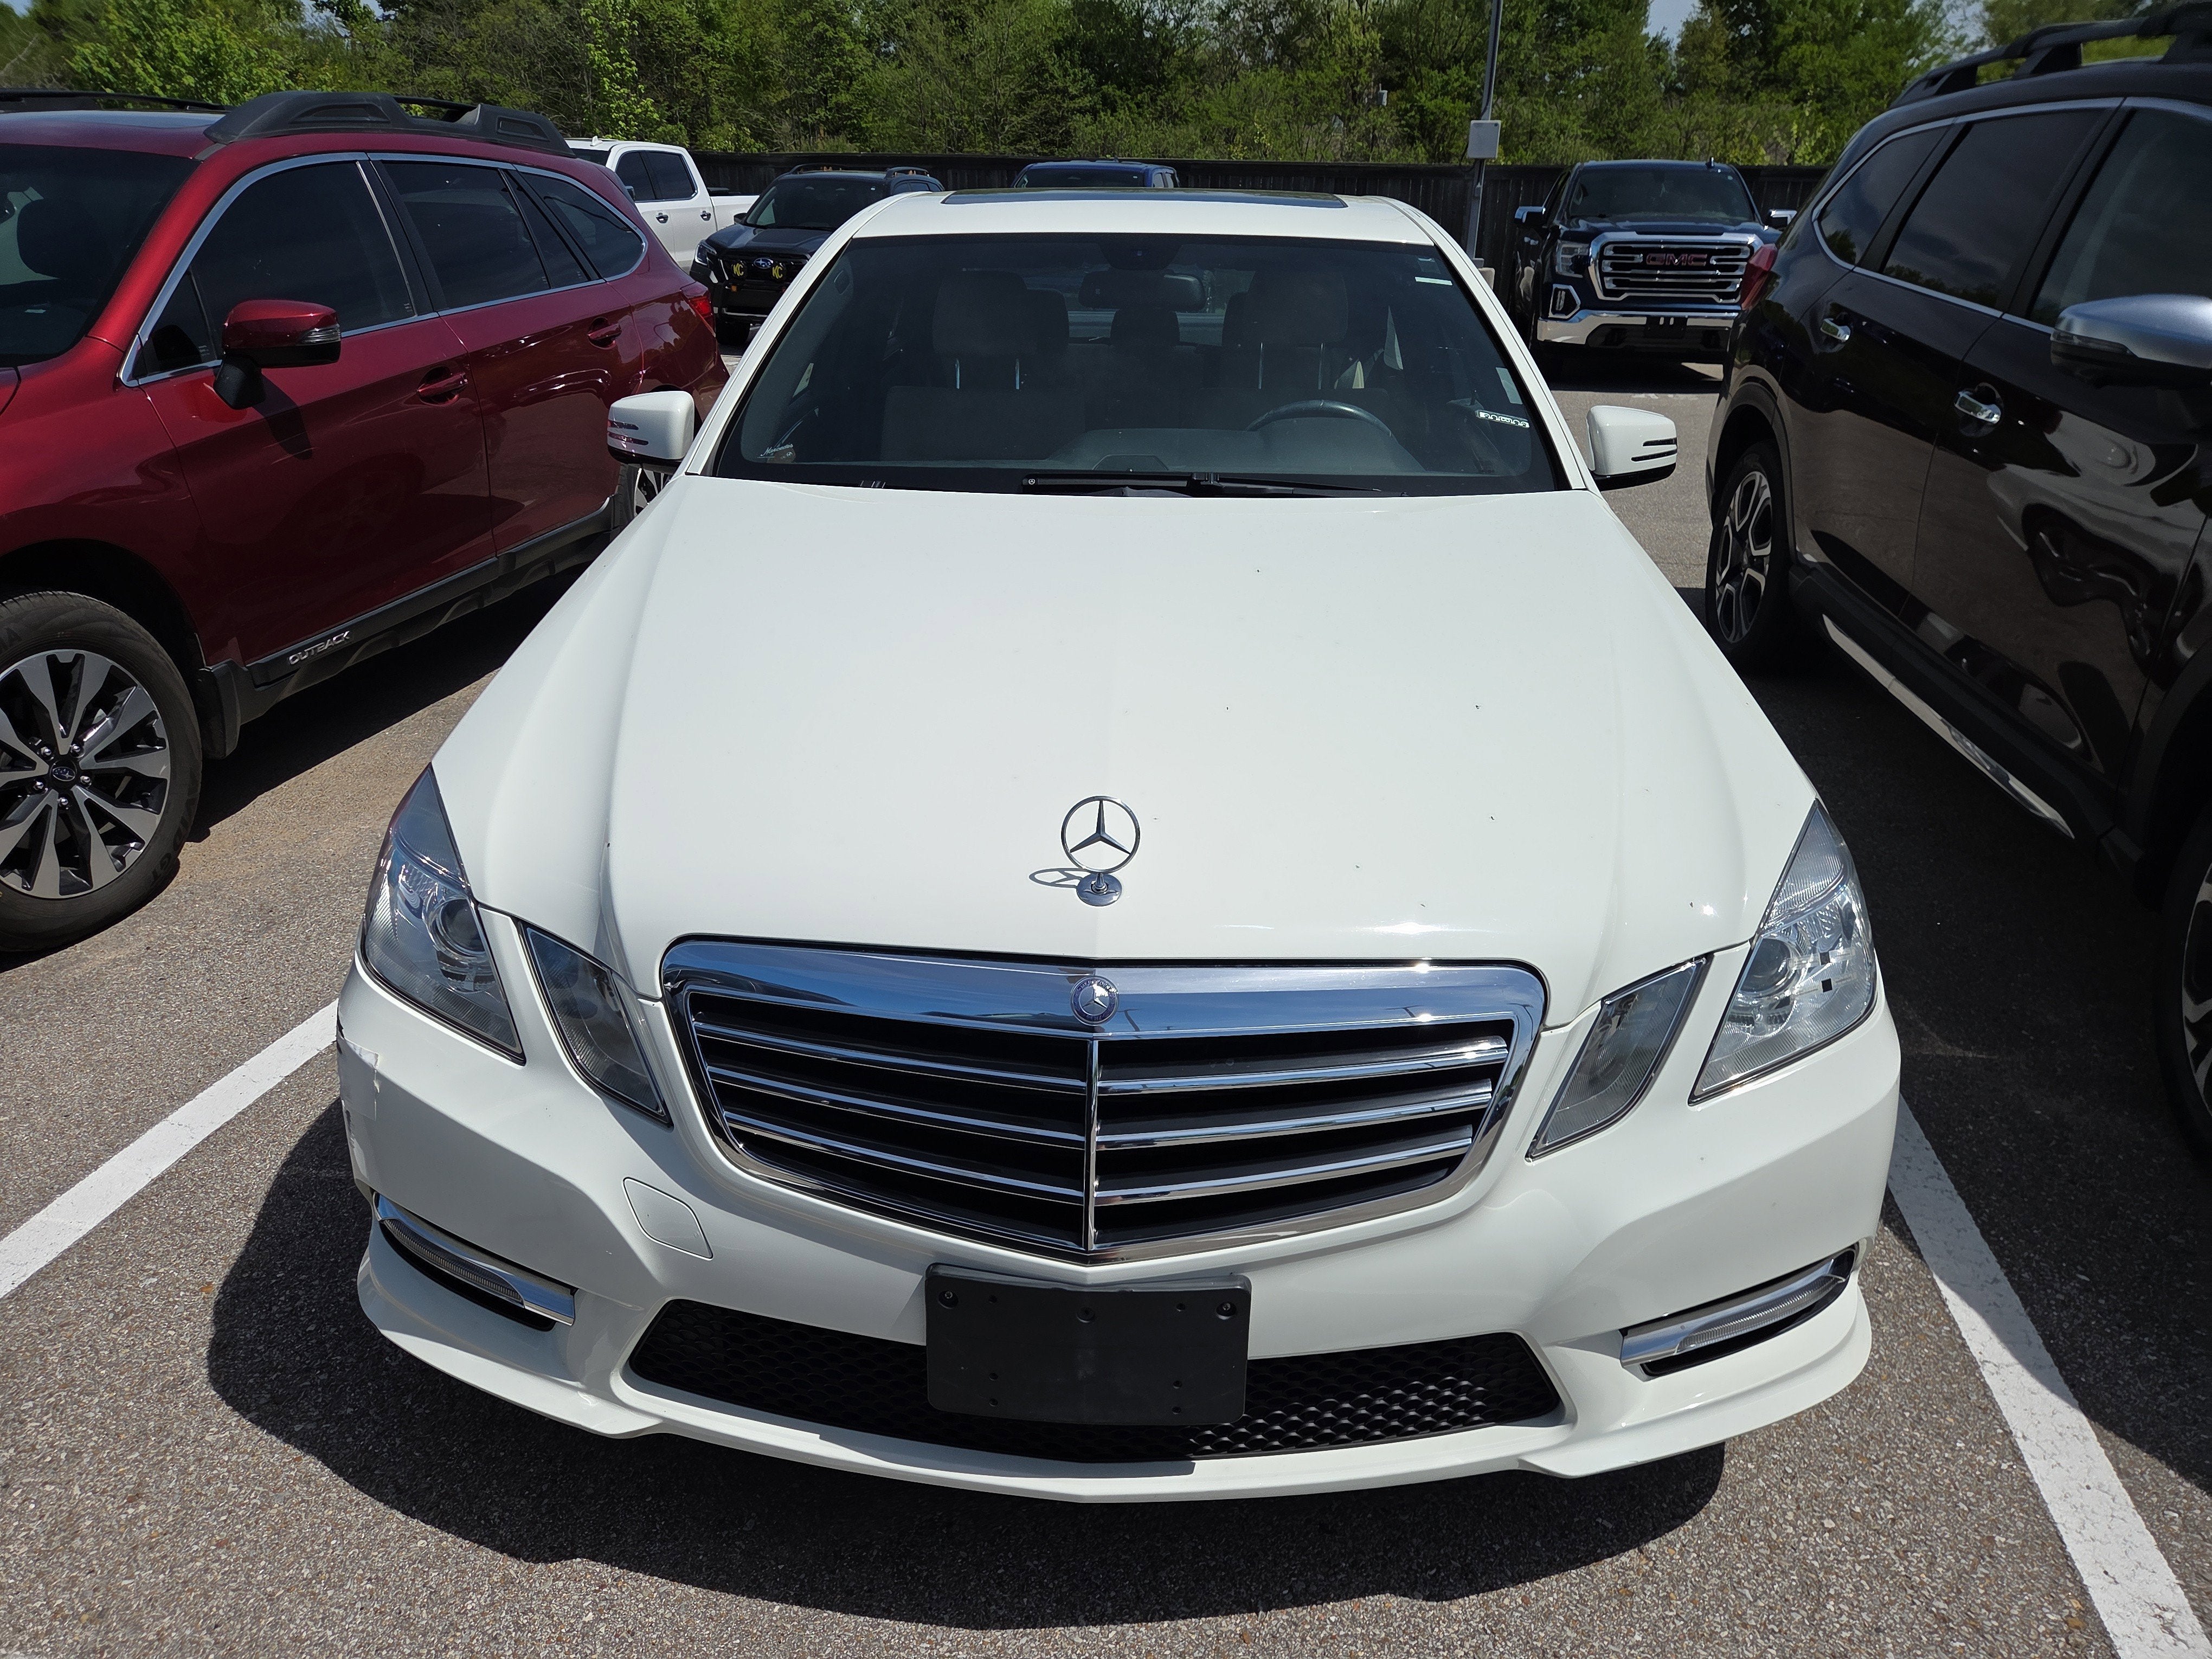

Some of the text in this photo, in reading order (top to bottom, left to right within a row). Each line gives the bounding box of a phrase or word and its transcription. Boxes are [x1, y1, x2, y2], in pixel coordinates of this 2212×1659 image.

[1645, 253, 1708, 267] GMC
[733, 263, 744, 276] KC
[772, 265, 783, 279] KC
[760, 443, 793, 456] Mercedes
[289, 631, 350, 665] OUTBACK
